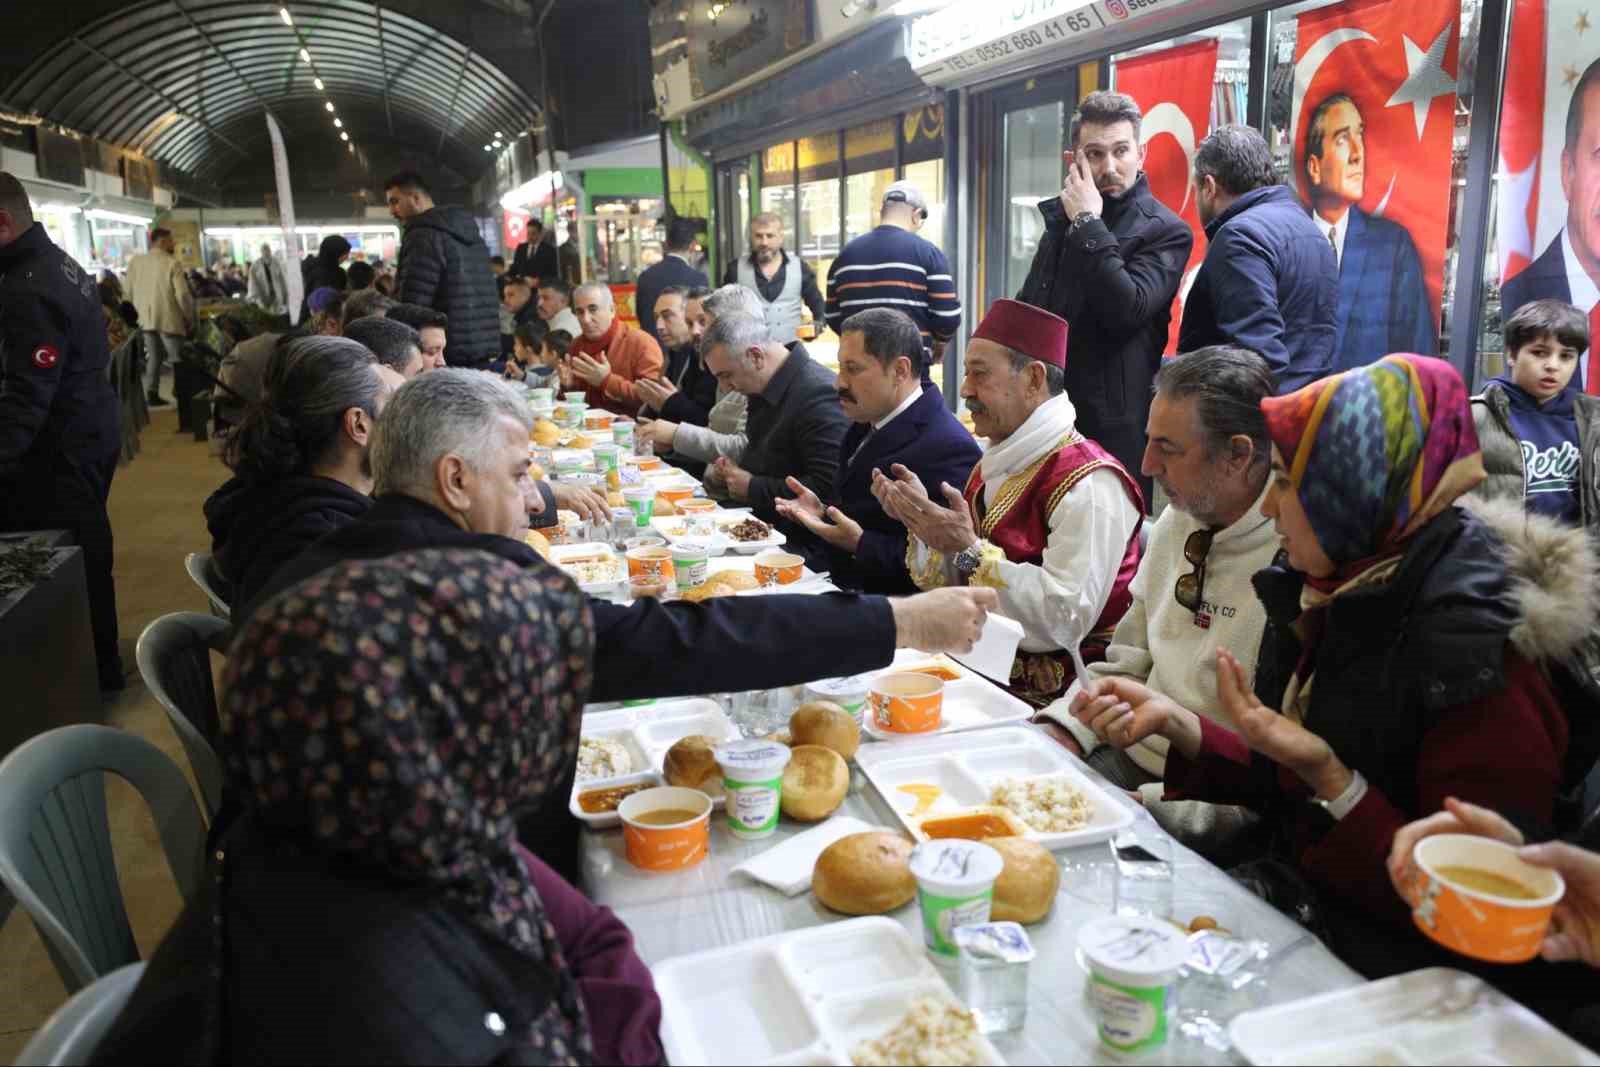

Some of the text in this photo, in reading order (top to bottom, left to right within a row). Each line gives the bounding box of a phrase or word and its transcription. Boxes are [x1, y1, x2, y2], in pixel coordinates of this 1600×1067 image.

[943, 53, 975, 72] TEL:
[976, 39, 1013, 61] 0552
[1011, 30, 1043, 50] 660
[1044, 21, 1065, 39] 41
[1066, 12, 1091, 32] 65
